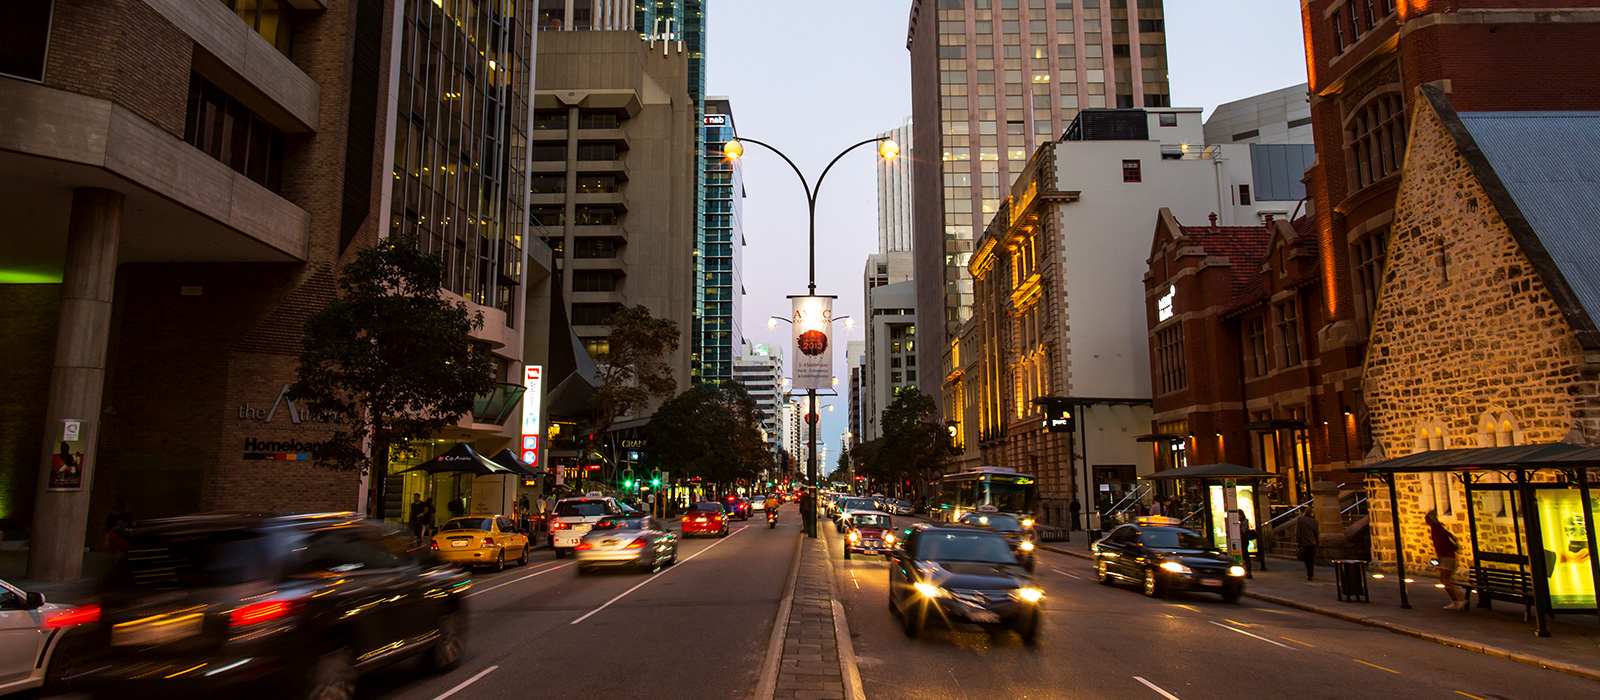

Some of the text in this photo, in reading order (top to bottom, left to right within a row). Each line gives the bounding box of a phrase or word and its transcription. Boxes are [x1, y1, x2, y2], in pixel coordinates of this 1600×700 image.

[709, 116, 723, 124] nab
[803, 342, 823, 350] 2013
[238, 403, 266, 420] the
[1052, 419, 1067, 427] pwc
